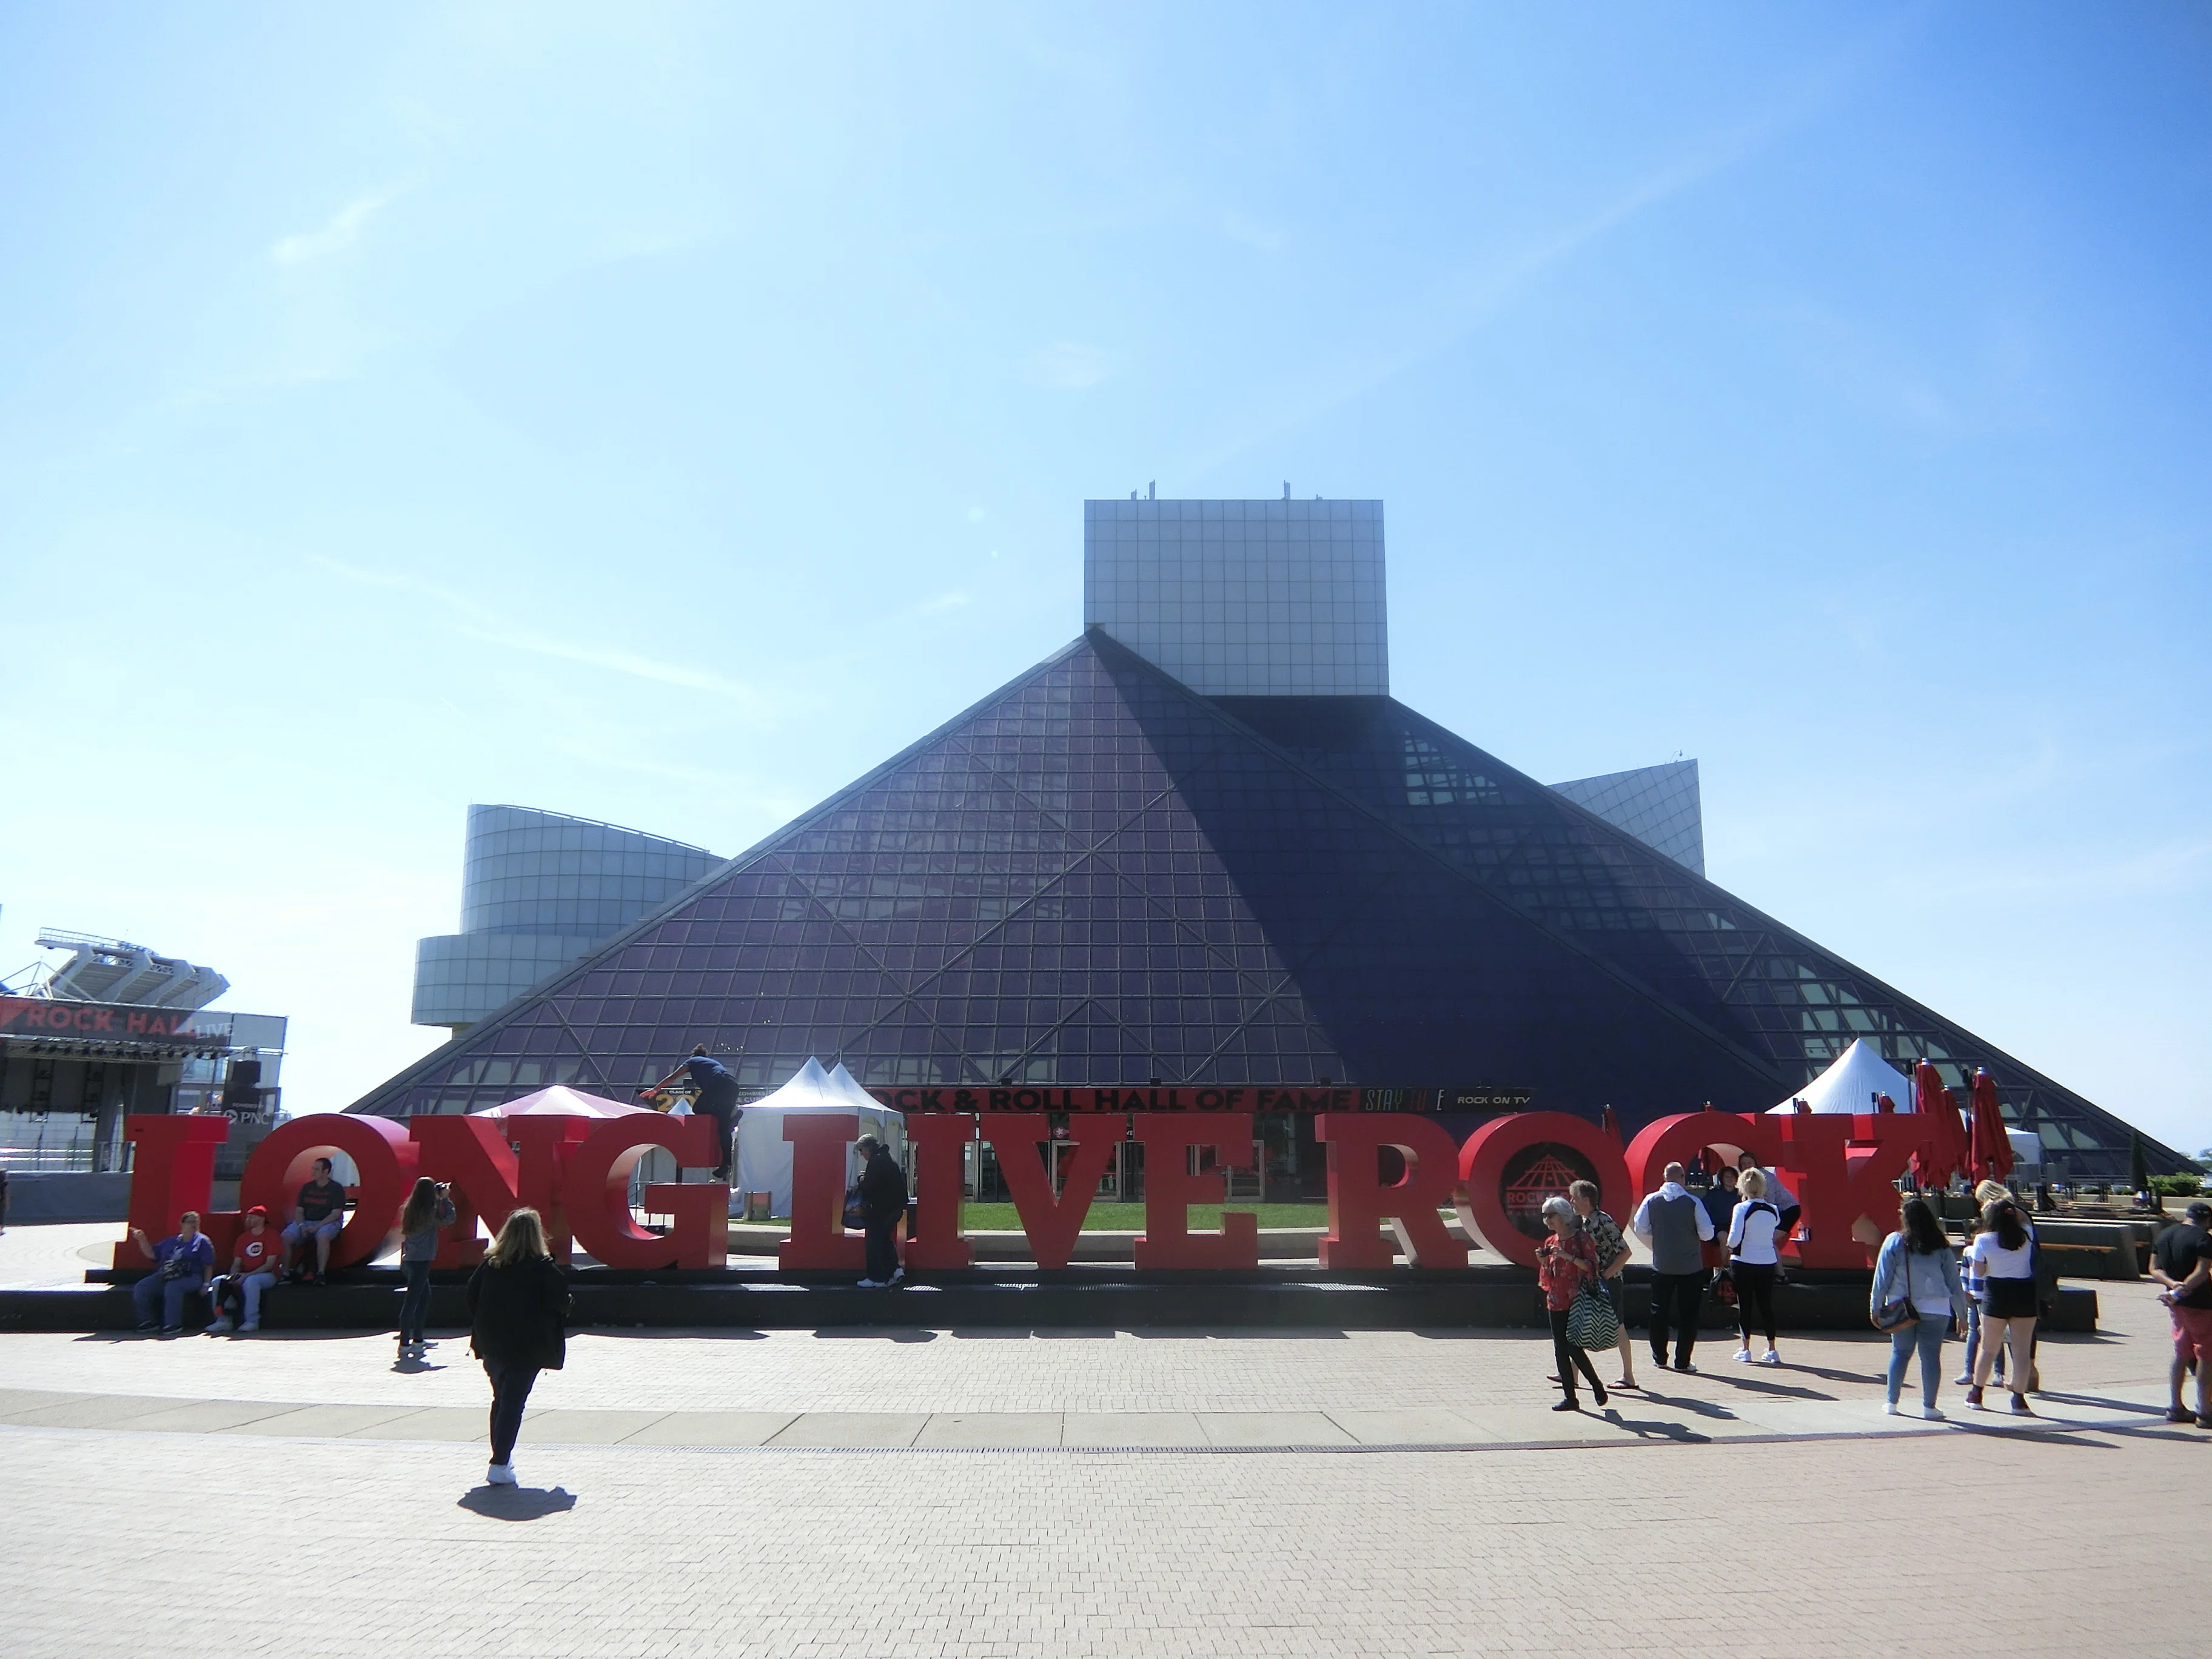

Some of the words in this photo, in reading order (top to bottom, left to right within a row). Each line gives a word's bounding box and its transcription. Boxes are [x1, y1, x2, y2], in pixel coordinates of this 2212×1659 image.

[26, 1005, 115, 1032] ROCK
[127, 1011, 197, 1037] HALL
[196, 1022, 235, 1039] LIVE
[873, 1090, 945, 1111] OCK
[954, 1090, 980, 1111] &
[990, 1090, 1081, 1111] ROLL
[1094, 1090, 1187, 1111] HALL
[1195, 1090, 1244, 1111] OF
[1257, 1090, 1352, 1111] FAME
[1365, 1089, 1404, 1111] STAY
[1458, 1096, 1489, 1105] ROCK
[1492, 1096, 1511, 1105] ON
[1513, 1096, 1531, 1105] TV
[240, 1111, 270, 1125] PNC
[113, 1112, 728, 1270] LONG
[779, 1113, 1258, 1270] LIVE
[1315, 1111, 1939, 1270] ROCK
[1507, 1191, 1545, 1203] ROCK
